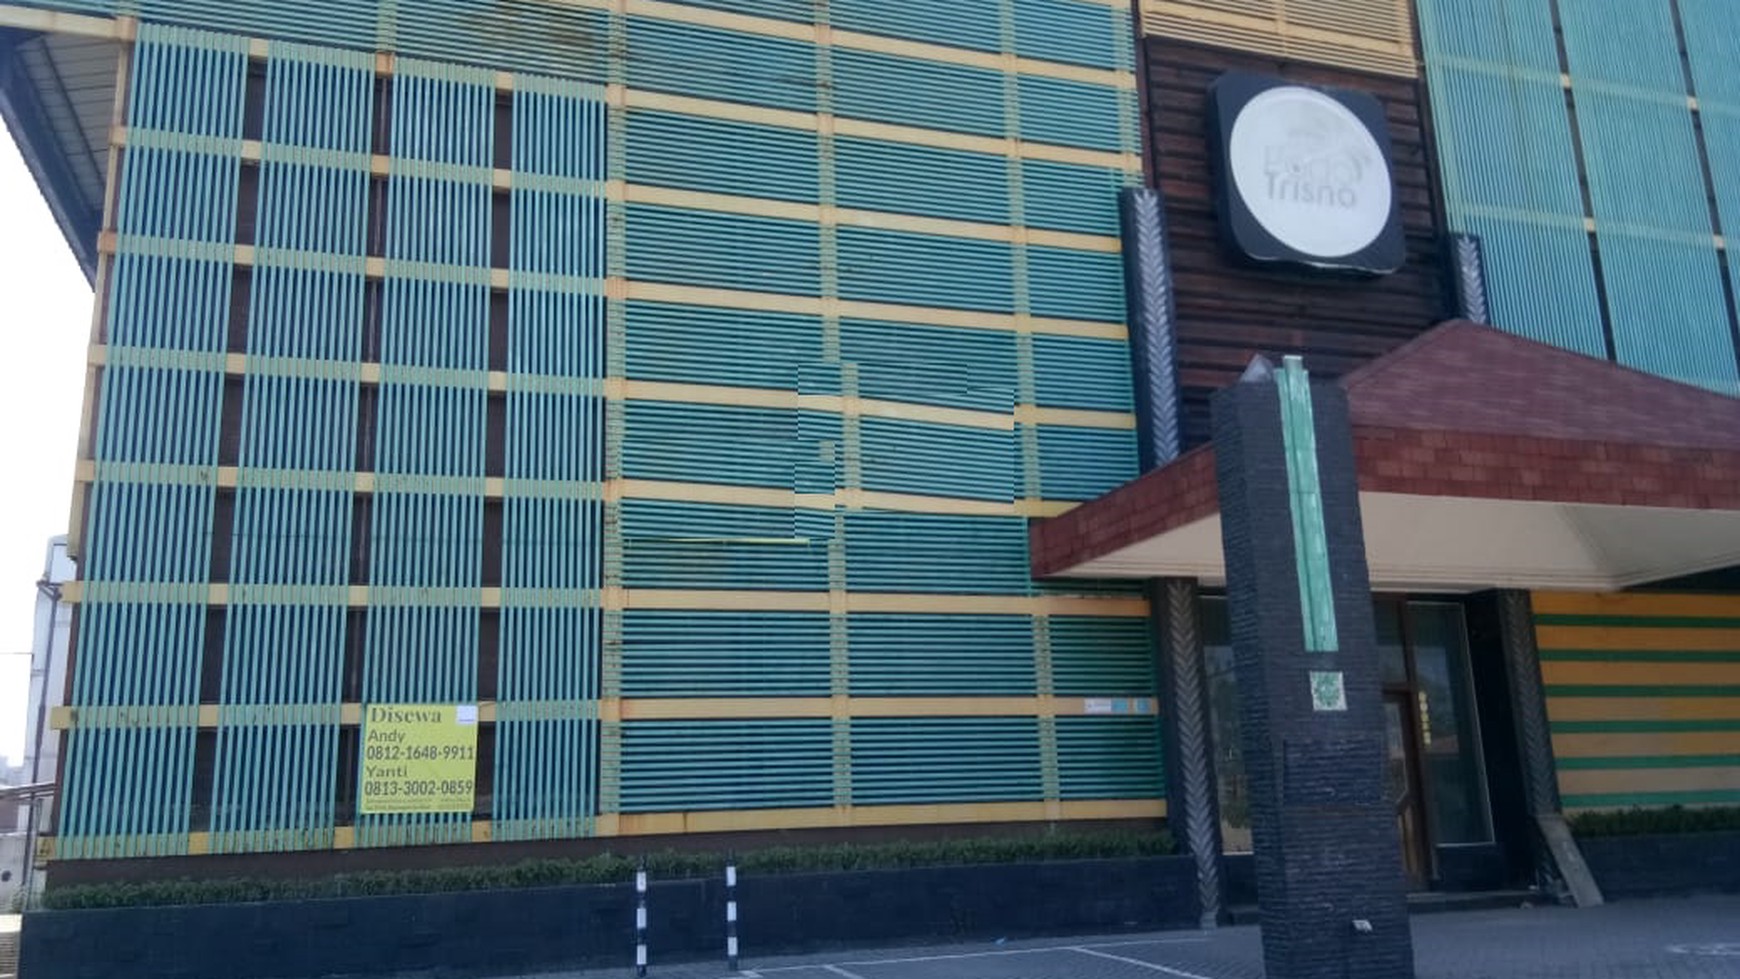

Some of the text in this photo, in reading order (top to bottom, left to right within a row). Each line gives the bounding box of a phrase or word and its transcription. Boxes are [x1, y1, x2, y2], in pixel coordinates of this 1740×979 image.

[371, 707, 442, 723] Disewa
[368, 729, 406, 743] Andy
[367, 745, 473, 760] 0812-1648-9911
[366, 765, 408, 778] Yanti
[365, 780, 473, 795] 0813-3002-0859
